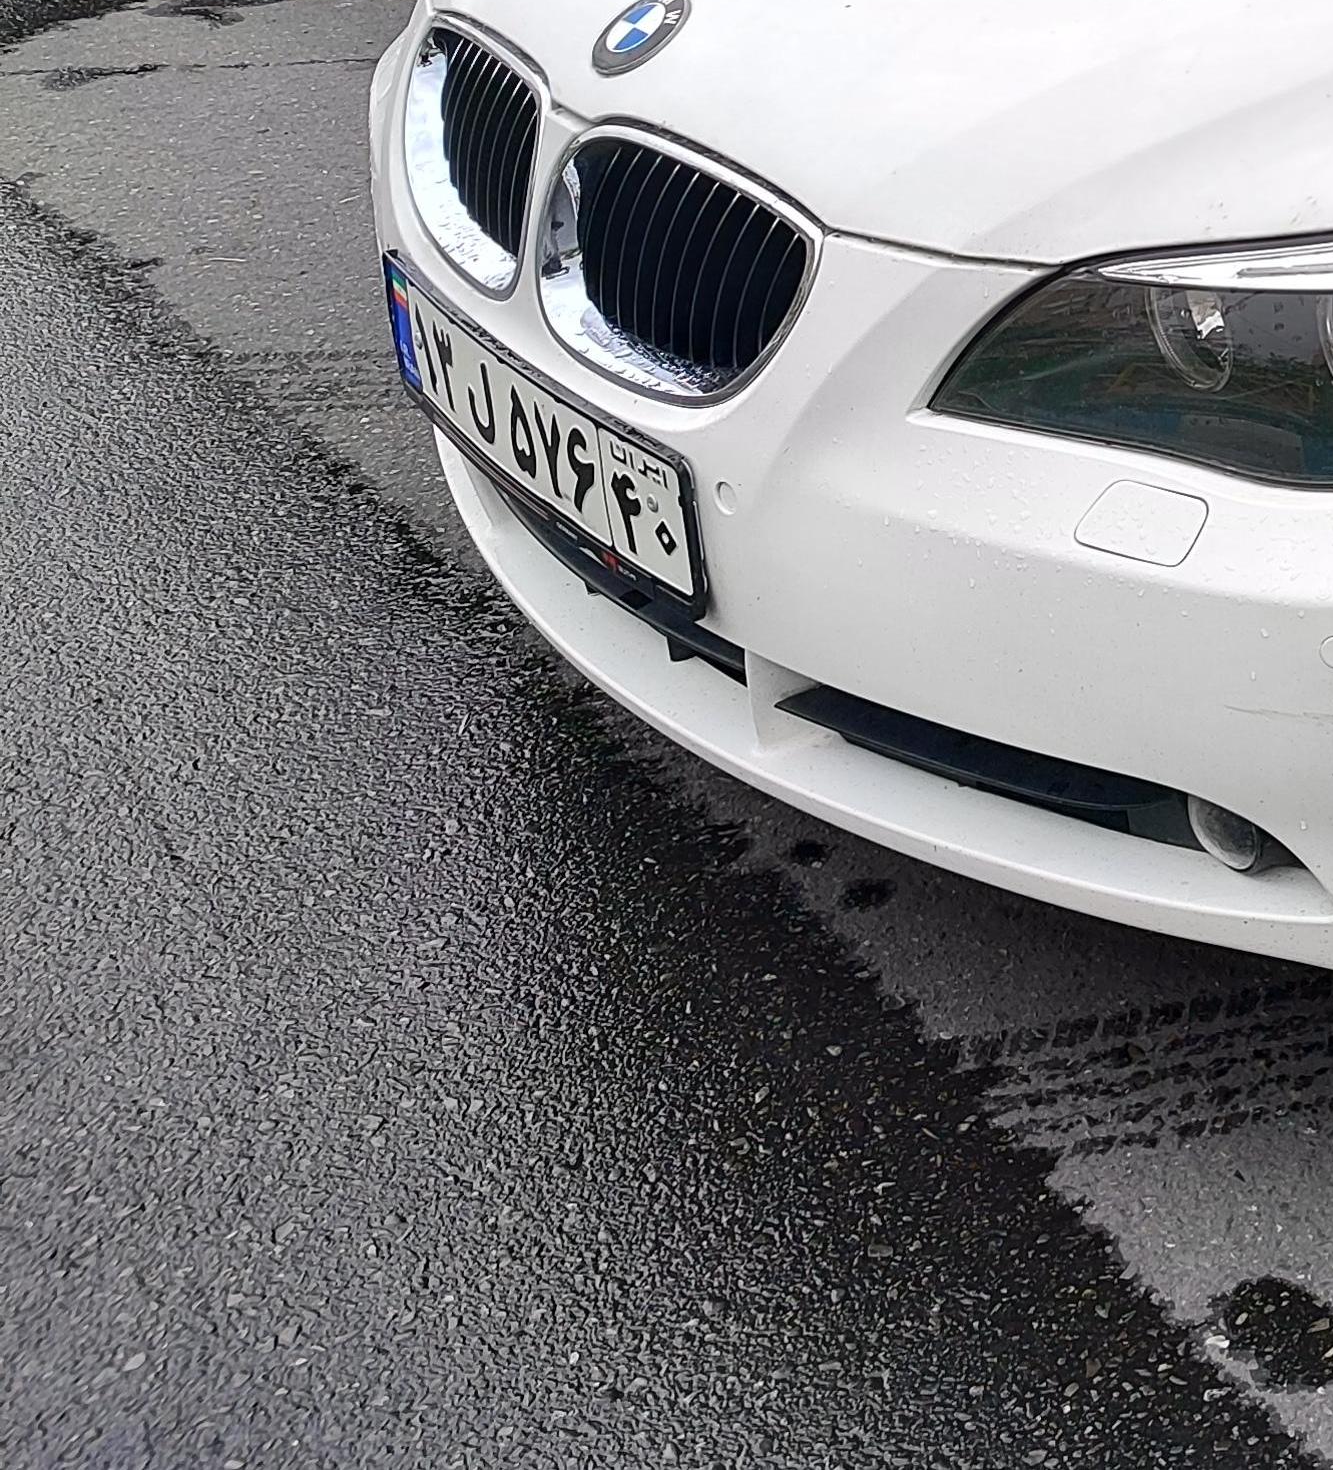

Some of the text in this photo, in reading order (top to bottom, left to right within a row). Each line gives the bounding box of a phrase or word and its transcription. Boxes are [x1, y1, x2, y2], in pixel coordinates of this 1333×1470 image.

[414, 302, 595, 514] ۱۳ ل ۵۷۶
[610, 471, 678, 557] ۴۰
